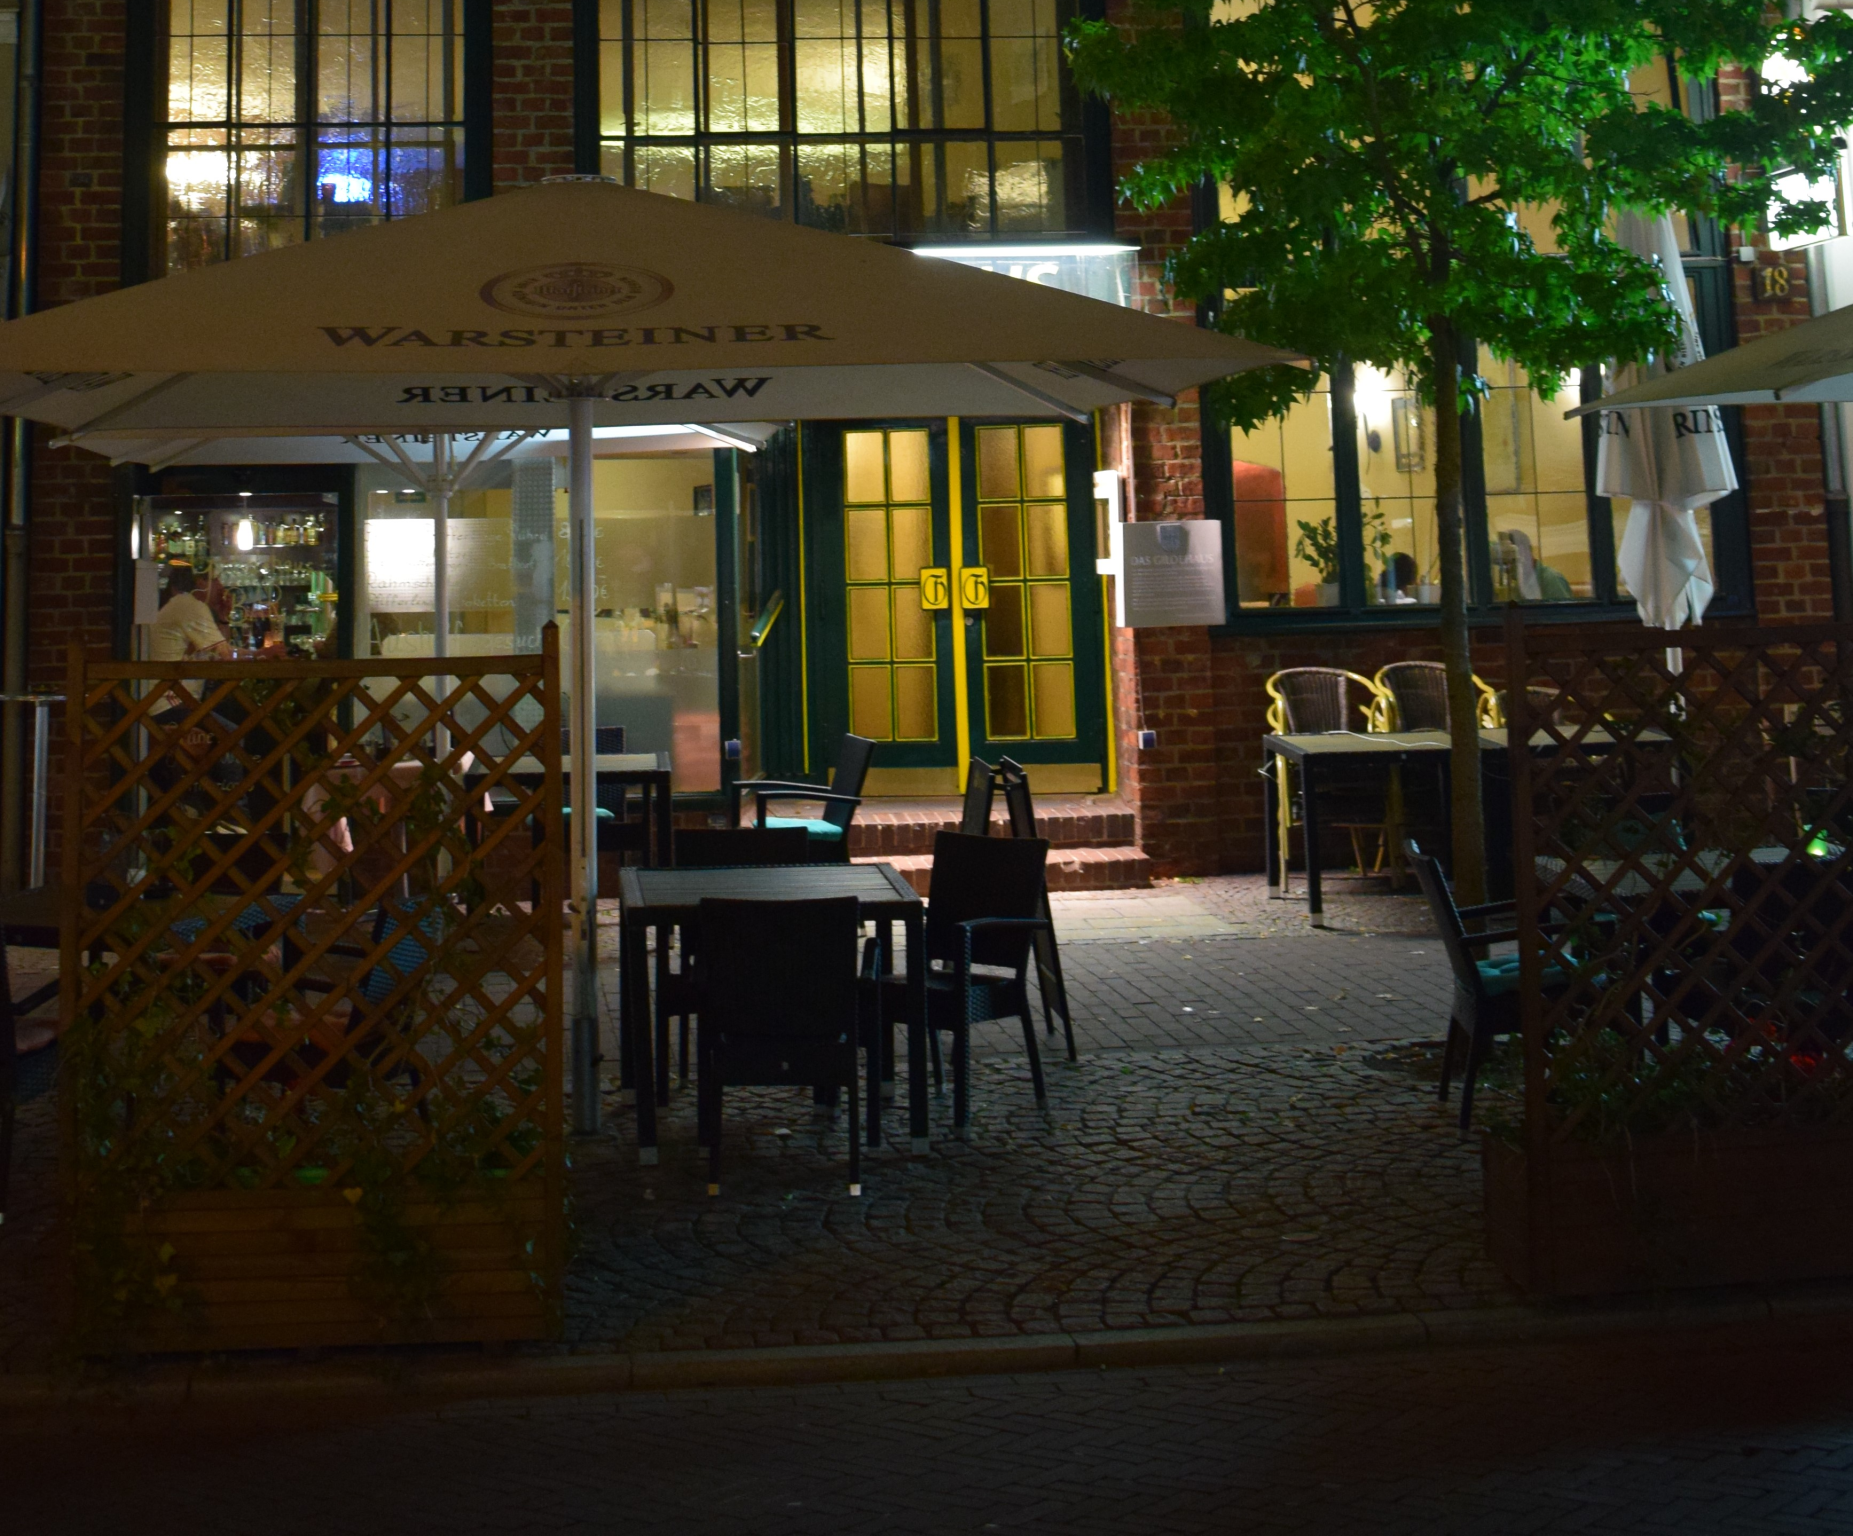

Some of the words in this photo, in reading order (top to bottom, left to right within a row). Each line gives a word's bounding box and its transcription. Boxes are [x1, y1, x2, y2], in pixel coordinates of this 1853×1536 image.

[1761, 267, 1789, 297] 18
[316, 324, 836, 348] WARSTEINER
[1130, 556, 1151, 566] DAS
